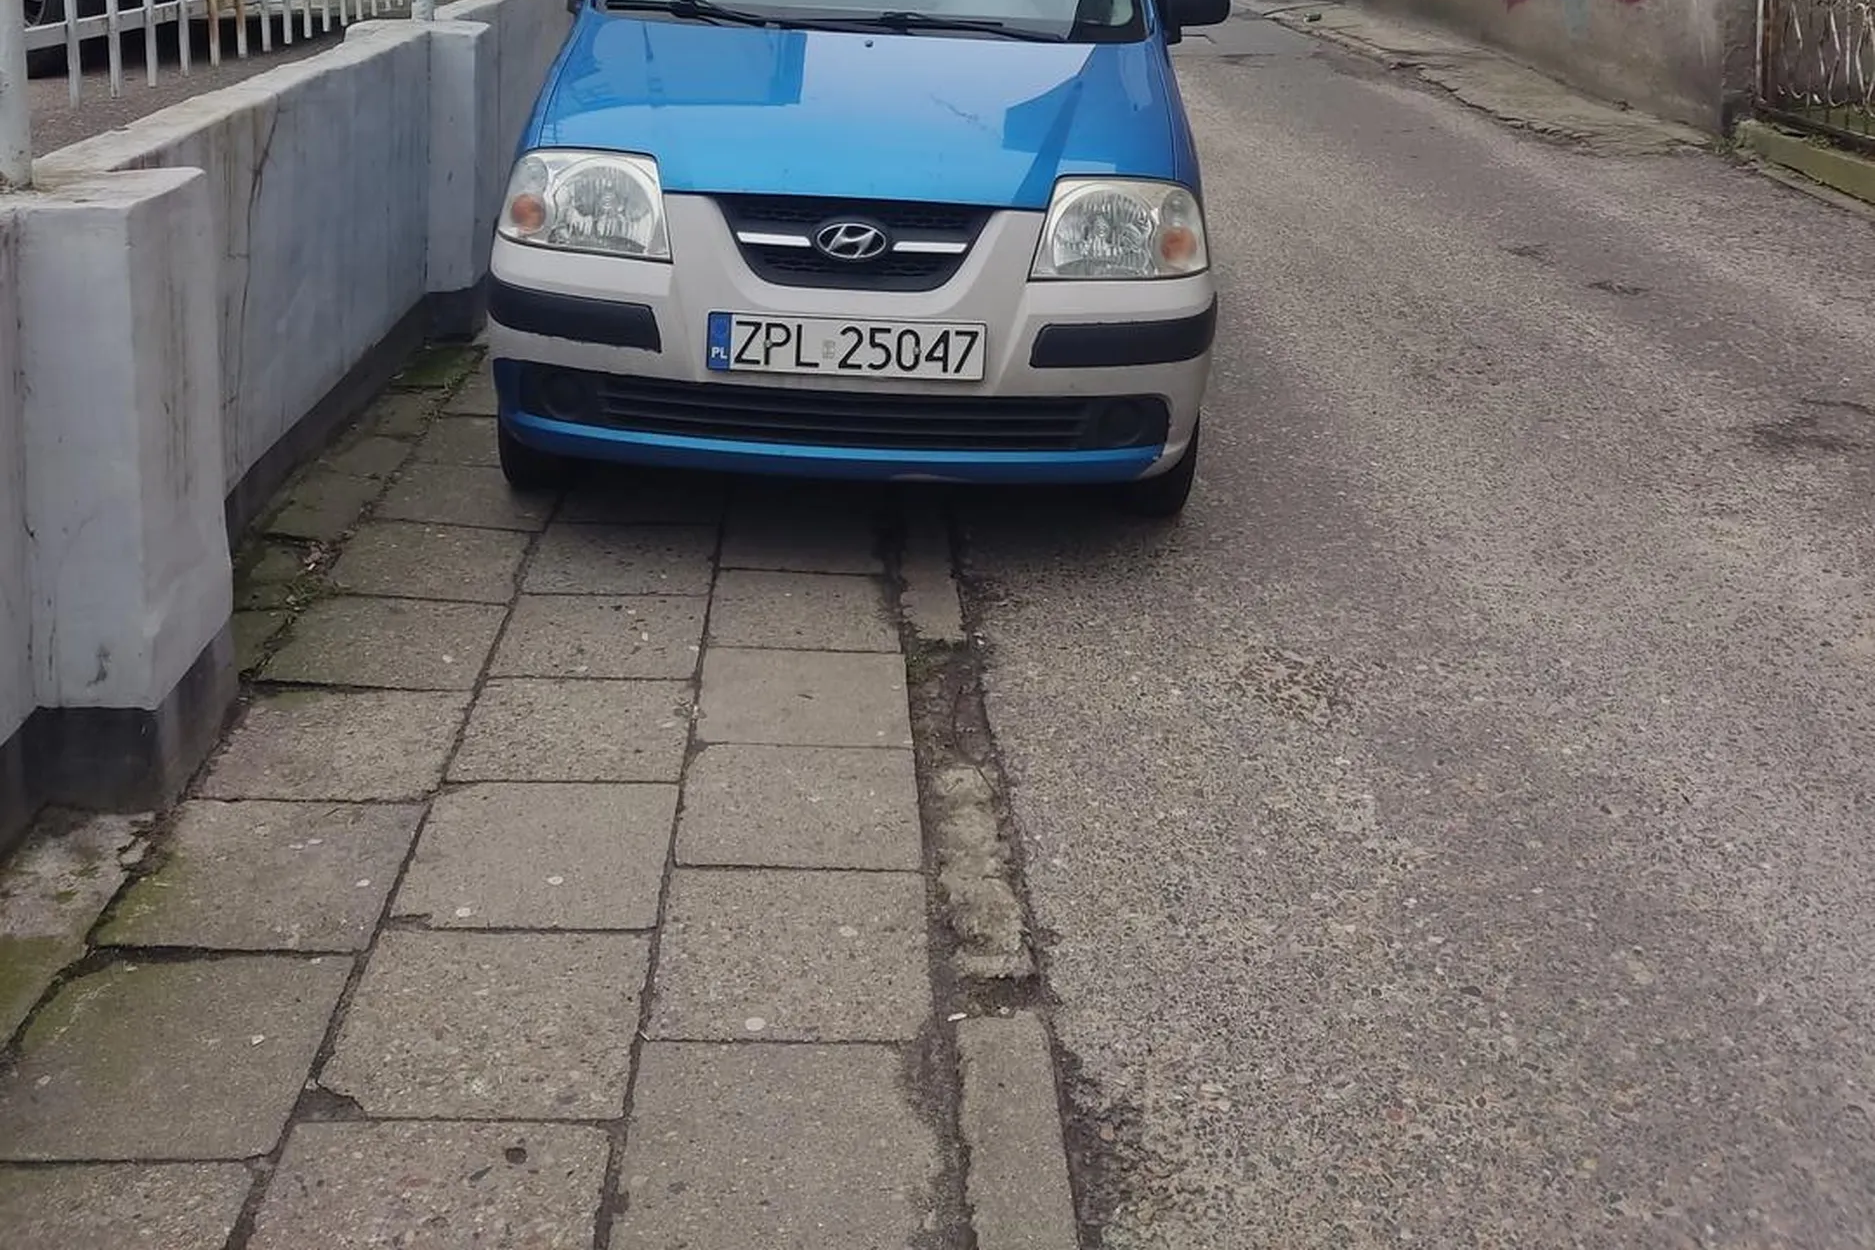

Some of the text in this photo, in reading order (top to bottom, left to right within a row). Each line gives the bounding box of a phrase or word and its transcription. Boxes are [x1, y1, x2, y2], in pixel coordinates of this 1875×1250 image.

[711, 346, 728, 359] PL
[733, 320, 980, 374] ZPL 25047
